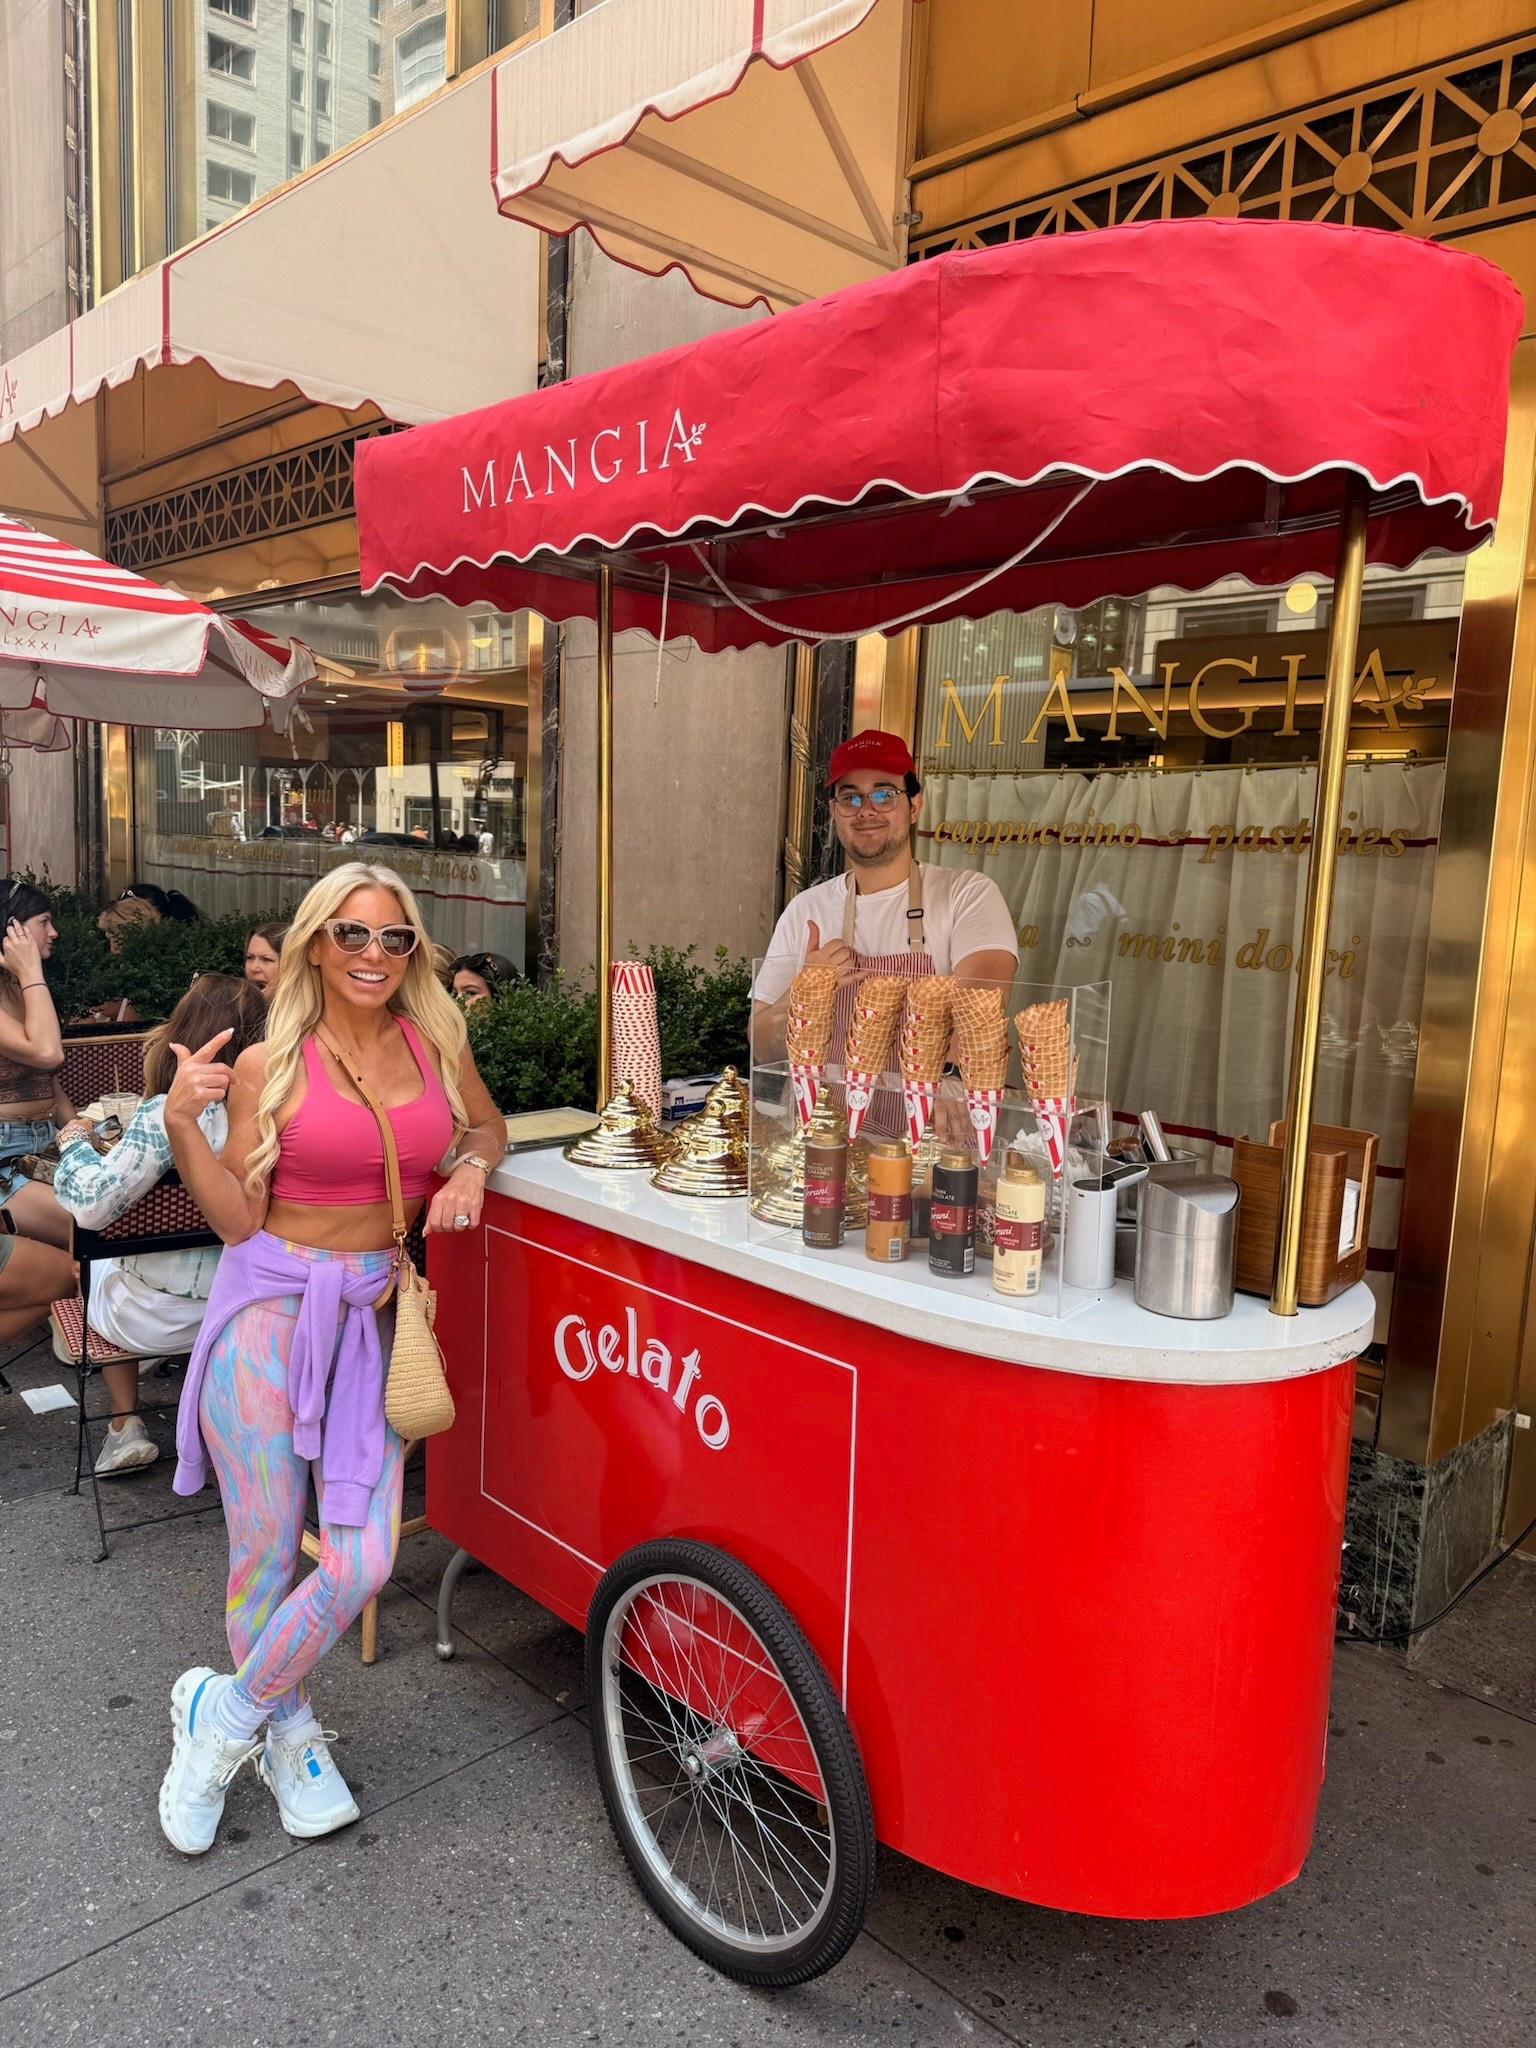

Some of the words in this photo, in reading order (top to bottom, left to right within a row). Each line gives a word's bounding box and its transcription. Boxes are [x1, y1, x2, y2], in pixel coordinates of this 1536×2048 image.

[461, 408, 706, 513] MANGIA
[934, 647, 1437, 749] MANGIA
[933, 808, 1142, 856] cappuccino
[1198, 811, 1411, 863] pasties
[1118, 922, 1225, 966] mini
[1235, 928, 1361, 979] doi
[554, 1306, 730, 1450] Gelato
